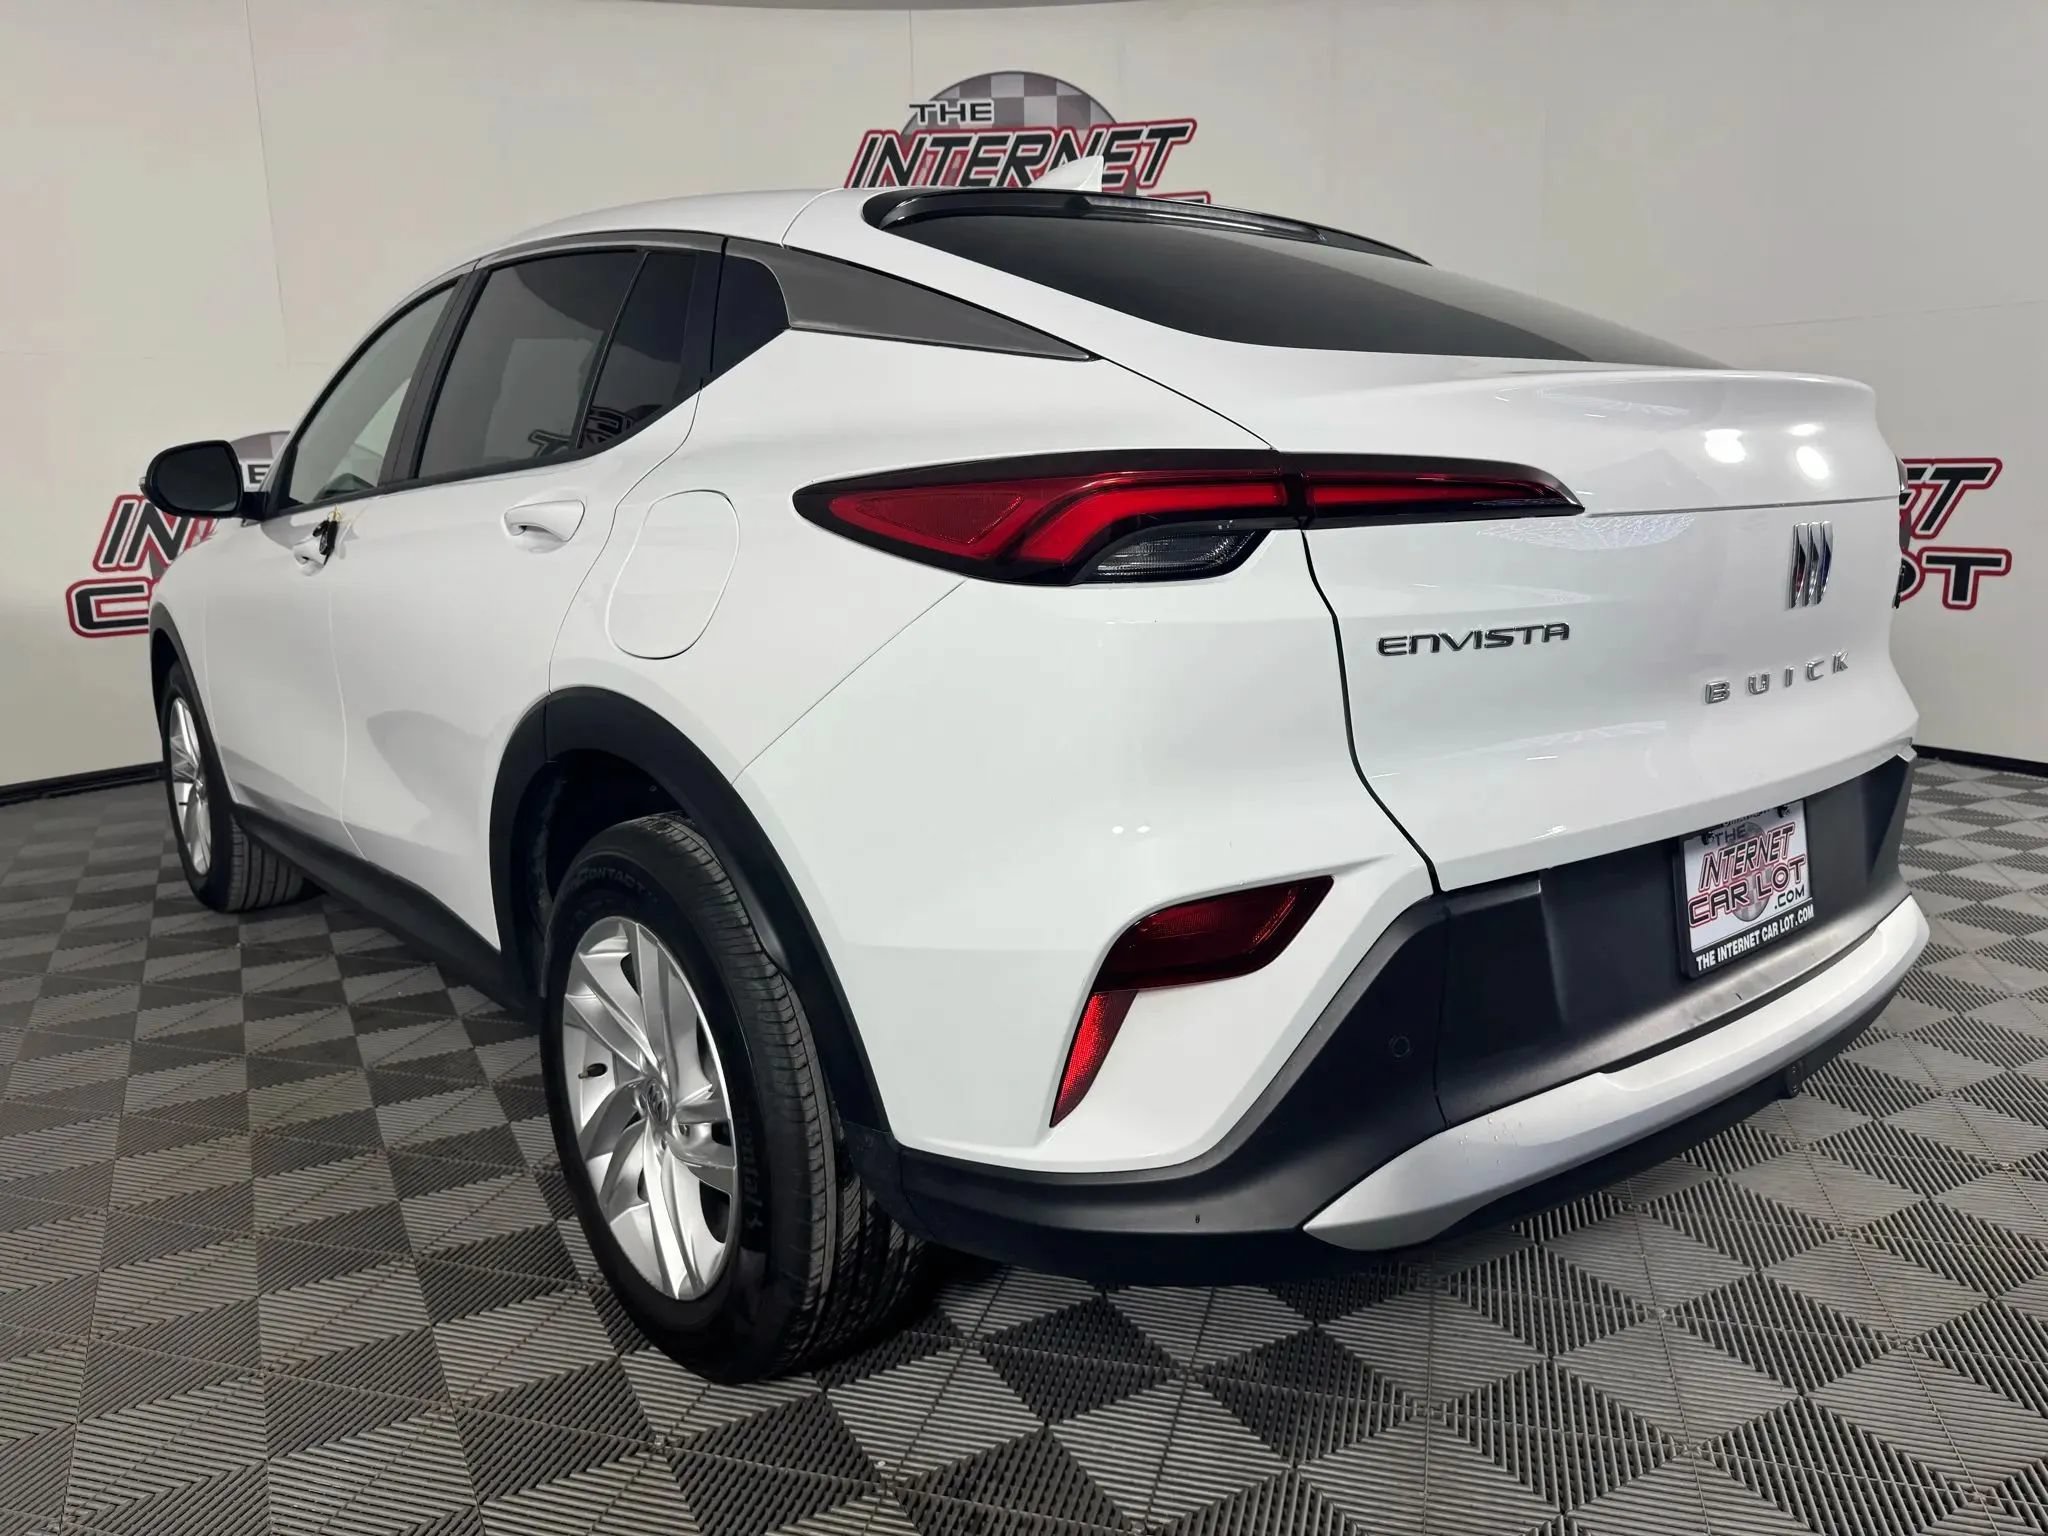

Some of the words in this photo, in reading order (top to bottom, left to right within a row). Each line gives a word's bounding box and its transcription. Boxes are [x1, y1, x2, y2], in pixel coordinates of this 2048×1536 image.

[908, 101, 994, 124] THE
[1376, 622, 1570, 656] ENVISTA
[1705, 649, 1849, 704] BUICK
[1699, 823, 1795, 891] INTERNET
[1714, 824, 1746, 846] THE
[1688, 878, 1749, 927] CAR
[1756, 855, 1805, 900] LOT
[1696, 953, 1716, 971] THE
[1718, 931, 1760, 962] INTERNET
[1761, 921, 1779, 941] CAR
